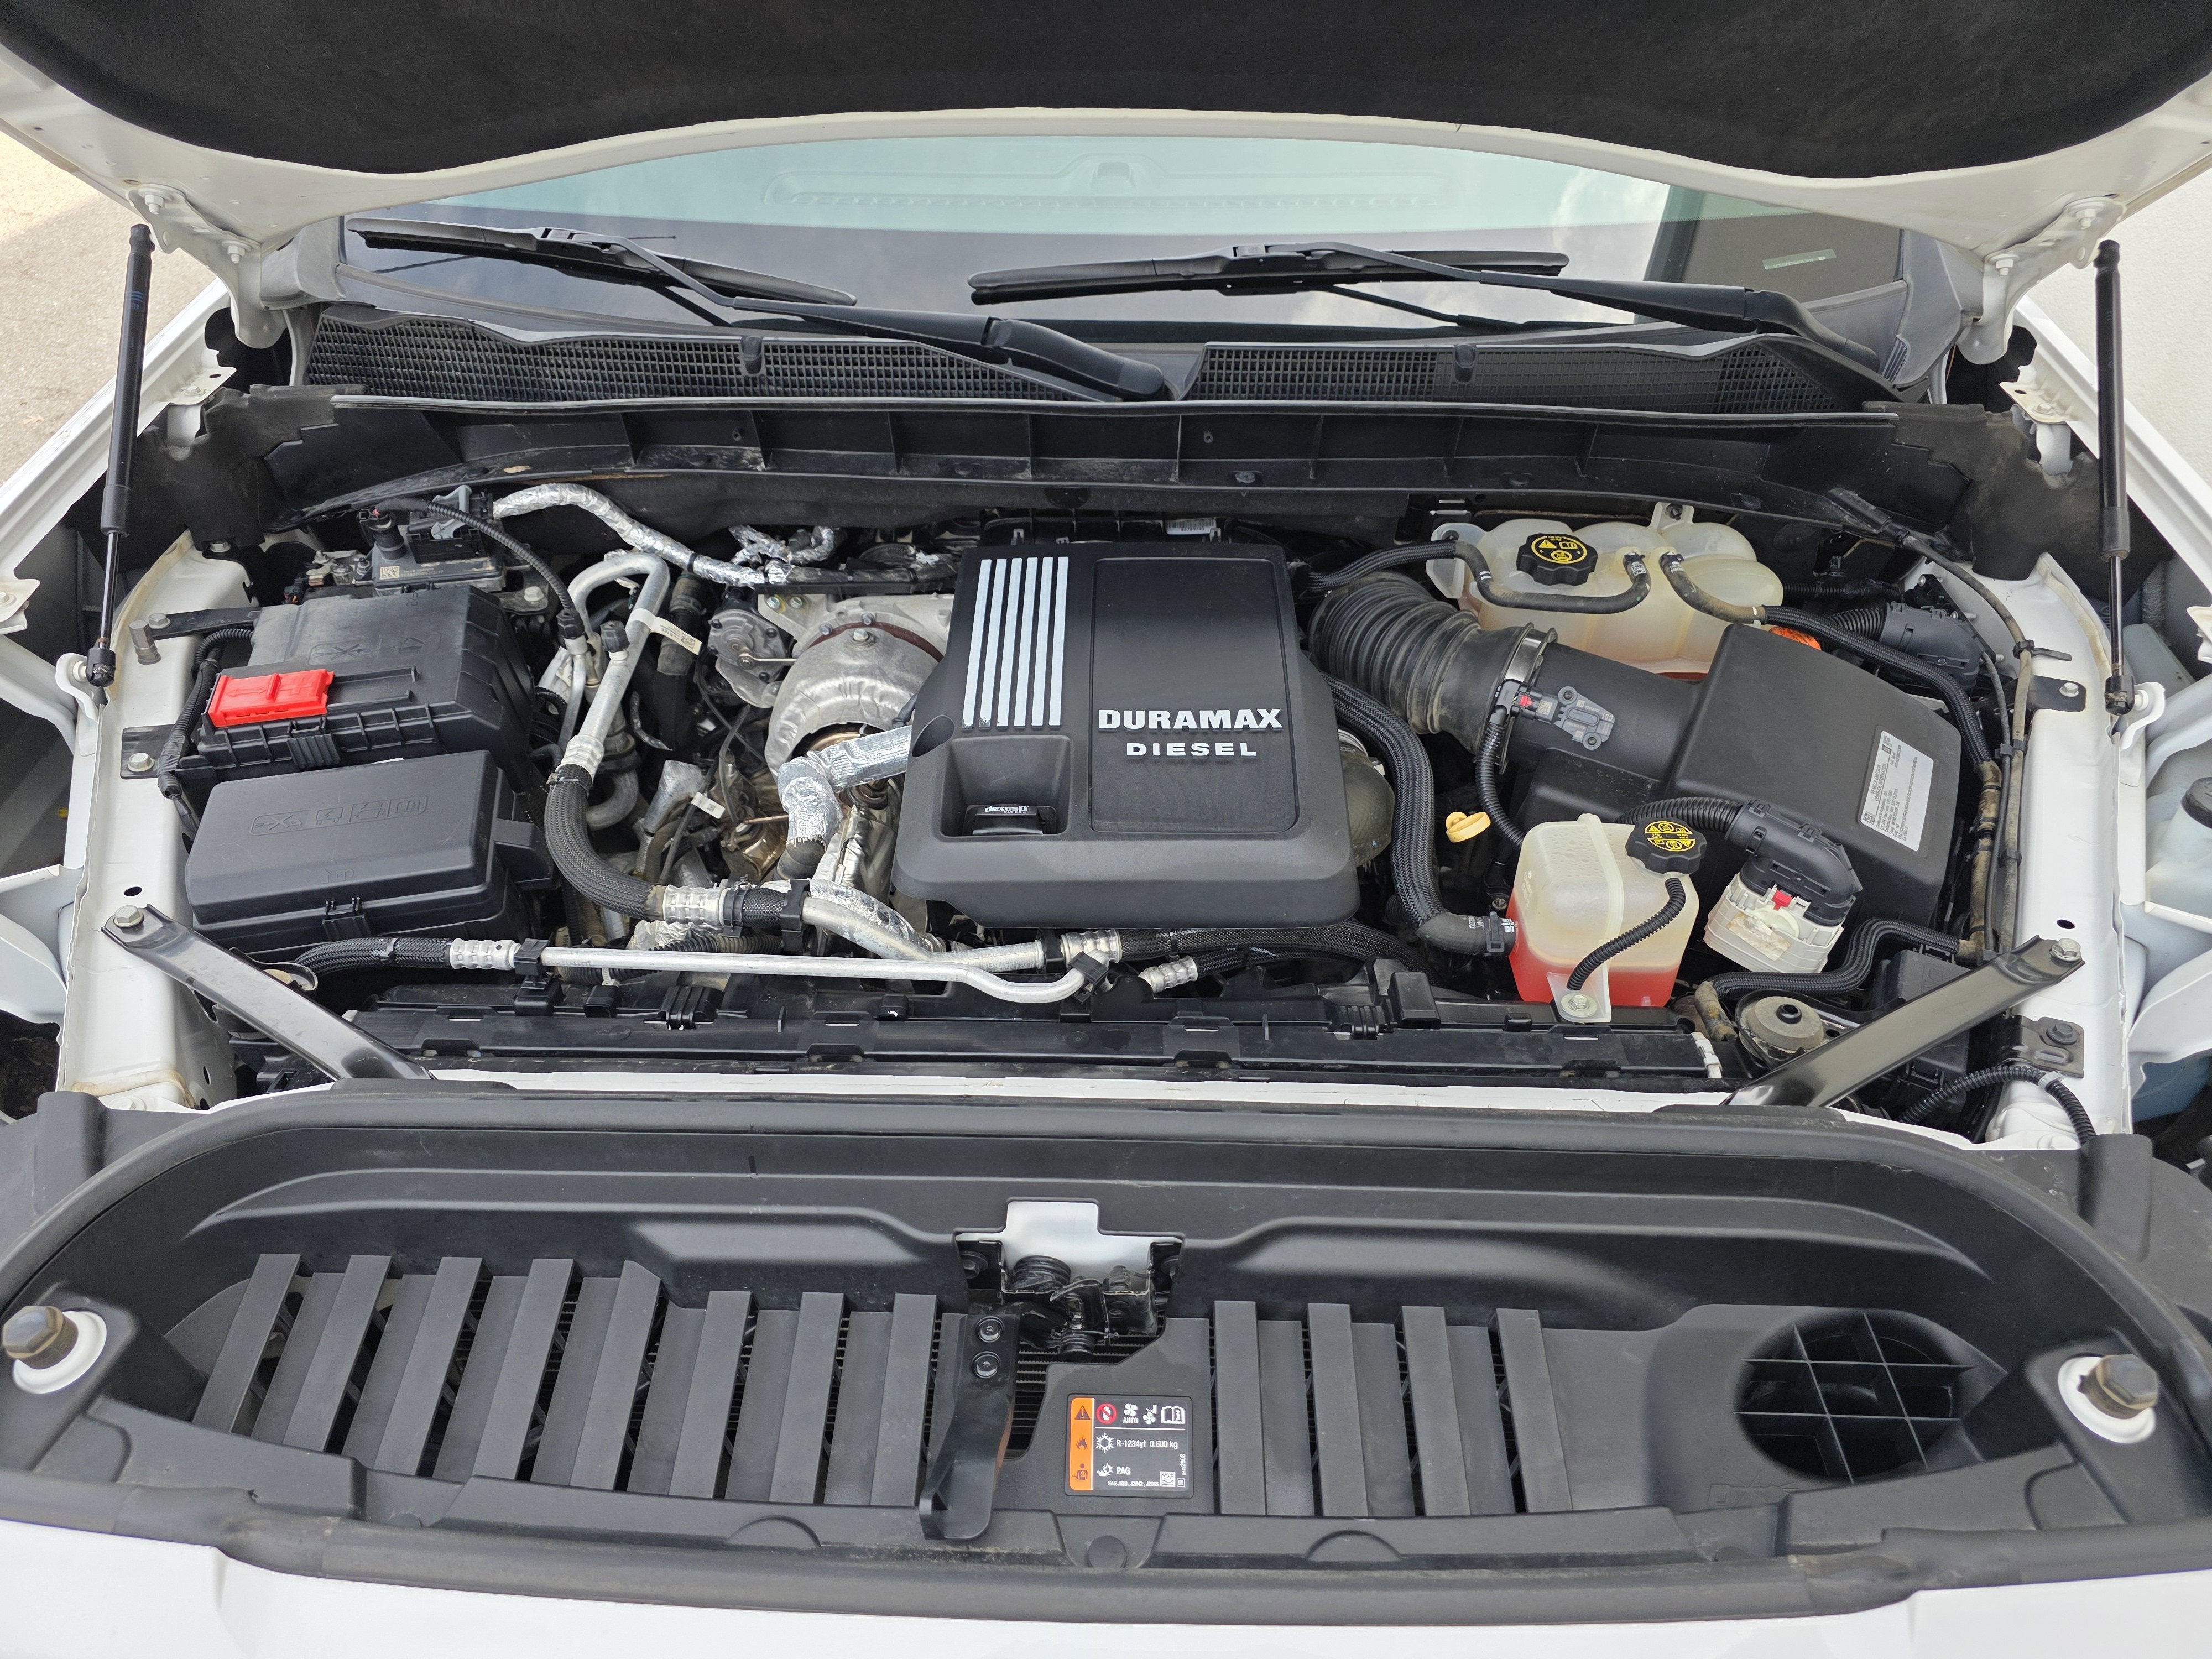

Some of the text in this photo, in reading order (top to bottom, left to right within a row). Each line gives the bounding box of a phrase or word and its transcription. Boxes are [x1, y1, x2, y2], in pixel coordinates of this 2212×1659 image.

[1098, 708, 1283, 729] DURAMAX
[1126, 742, 1256, 757] DIESEL
[1116, 1439, 1146, 1448] R-1234yf
[1169, 1441, 1178, 1449] kg
[1117, 1467, 1131, 1475] PAG
